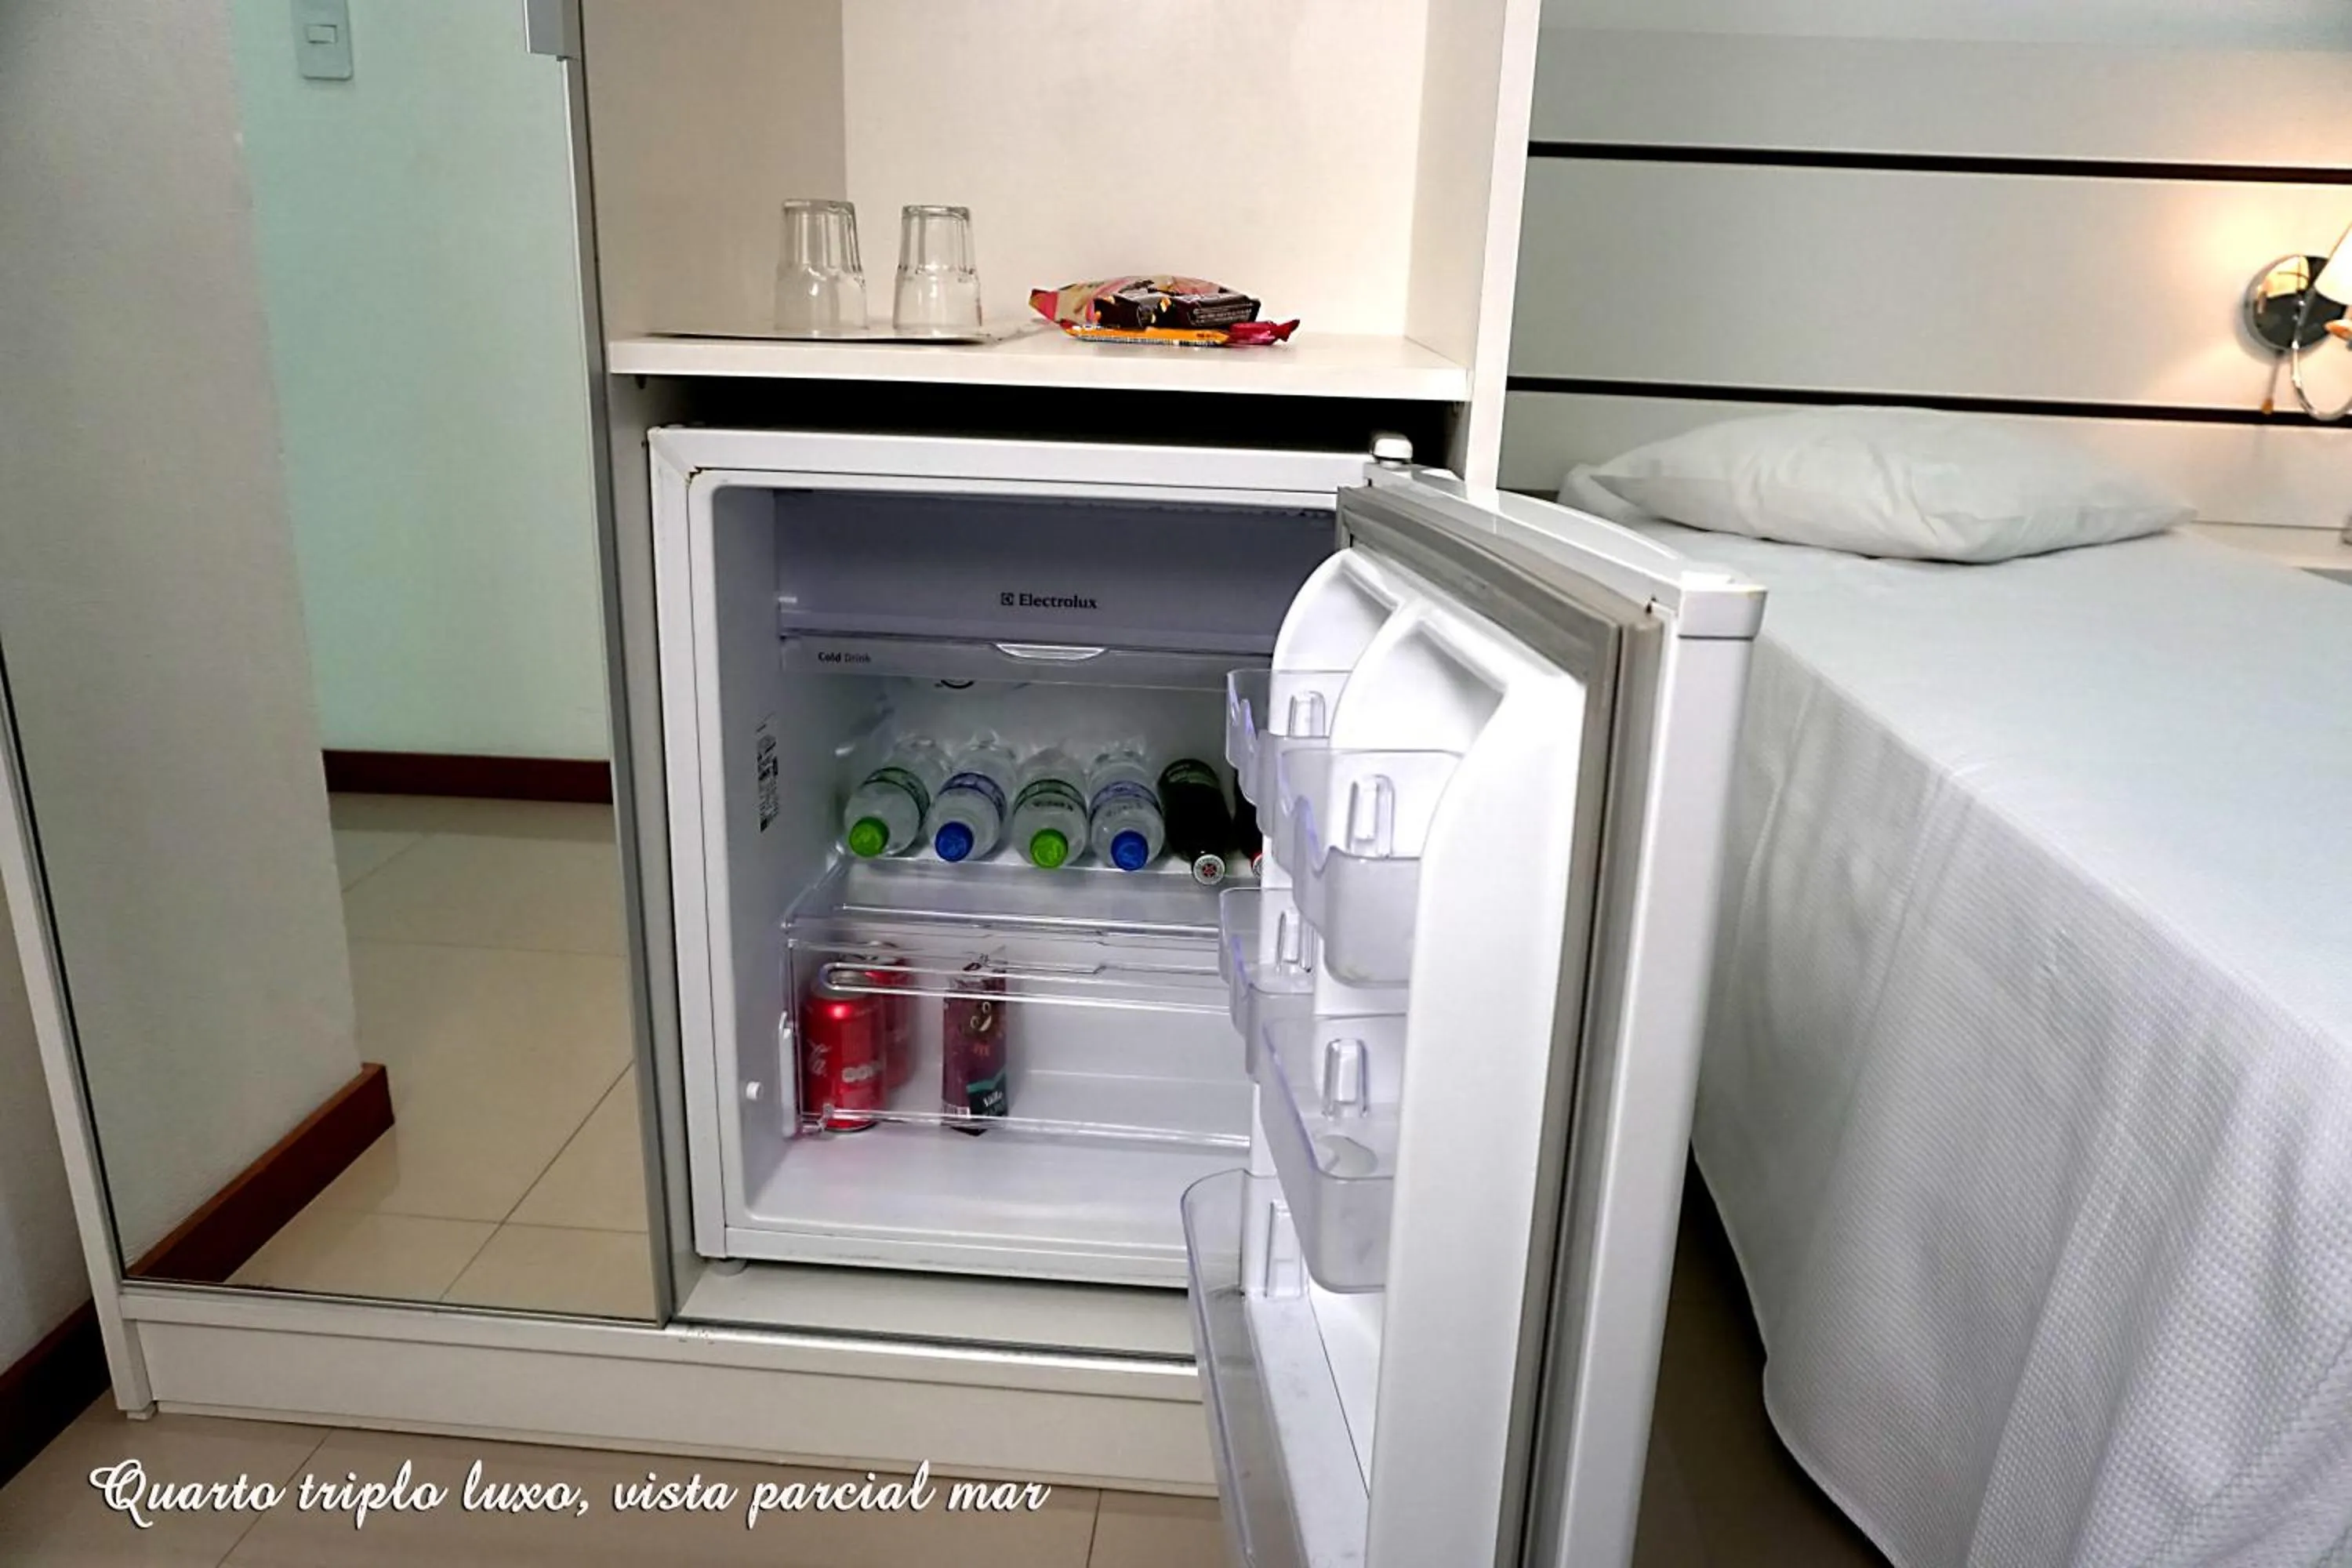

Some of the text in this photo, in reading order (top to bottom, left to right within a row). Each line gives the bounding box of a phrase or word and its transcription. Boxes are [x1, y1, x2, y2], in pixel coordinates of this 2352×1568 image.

[1018, 593, 1098, 609] Electrolux
[818, 652, 871, 663] Cold Drink
